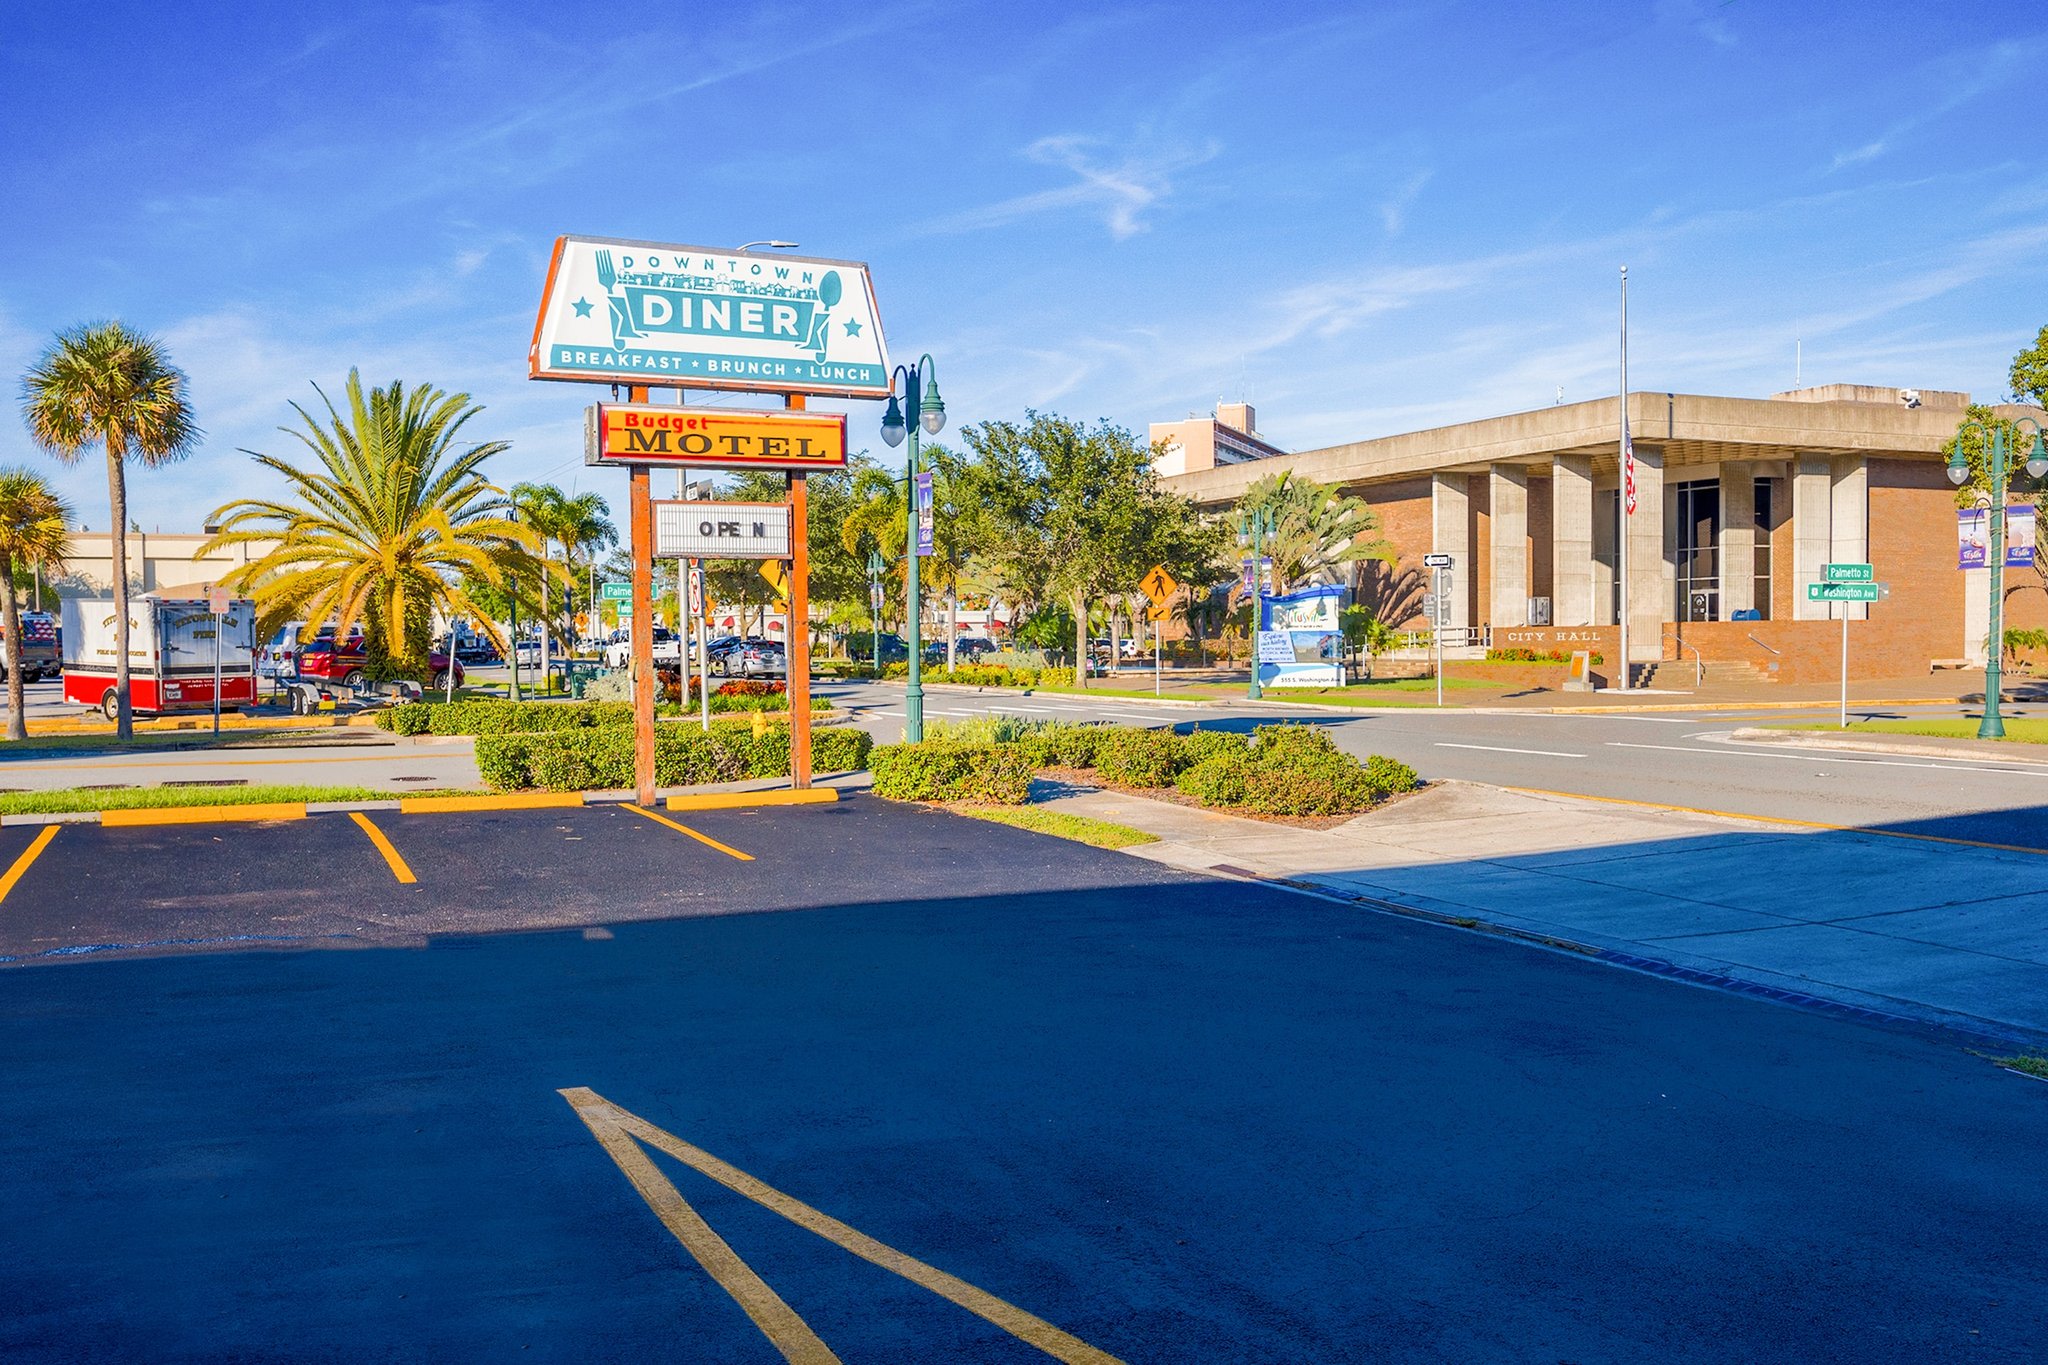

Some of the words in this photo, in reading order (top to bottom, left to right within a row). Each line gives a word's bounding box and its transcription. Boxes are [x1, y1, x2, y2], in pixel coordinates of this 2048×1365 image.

[623, 256, 813, 283] DOWNTOWN
[643, 294, 799, 336] DINER
[561, 350, 682, 370] BREAKFAST
[708, 359, 785, 376] BRUNCH
[810, 366, 870, 381] LUNCH
[625, 413, 709, 433] Budget
[624, 429, 826, 458] MOTEL
[1830, 567, 1861, 578] Palmetto
[1823, 588, 1862, 599] Washington
[1508, 632, 1545, 641] CITY
[1556, 632, 1600, 641] HALL
